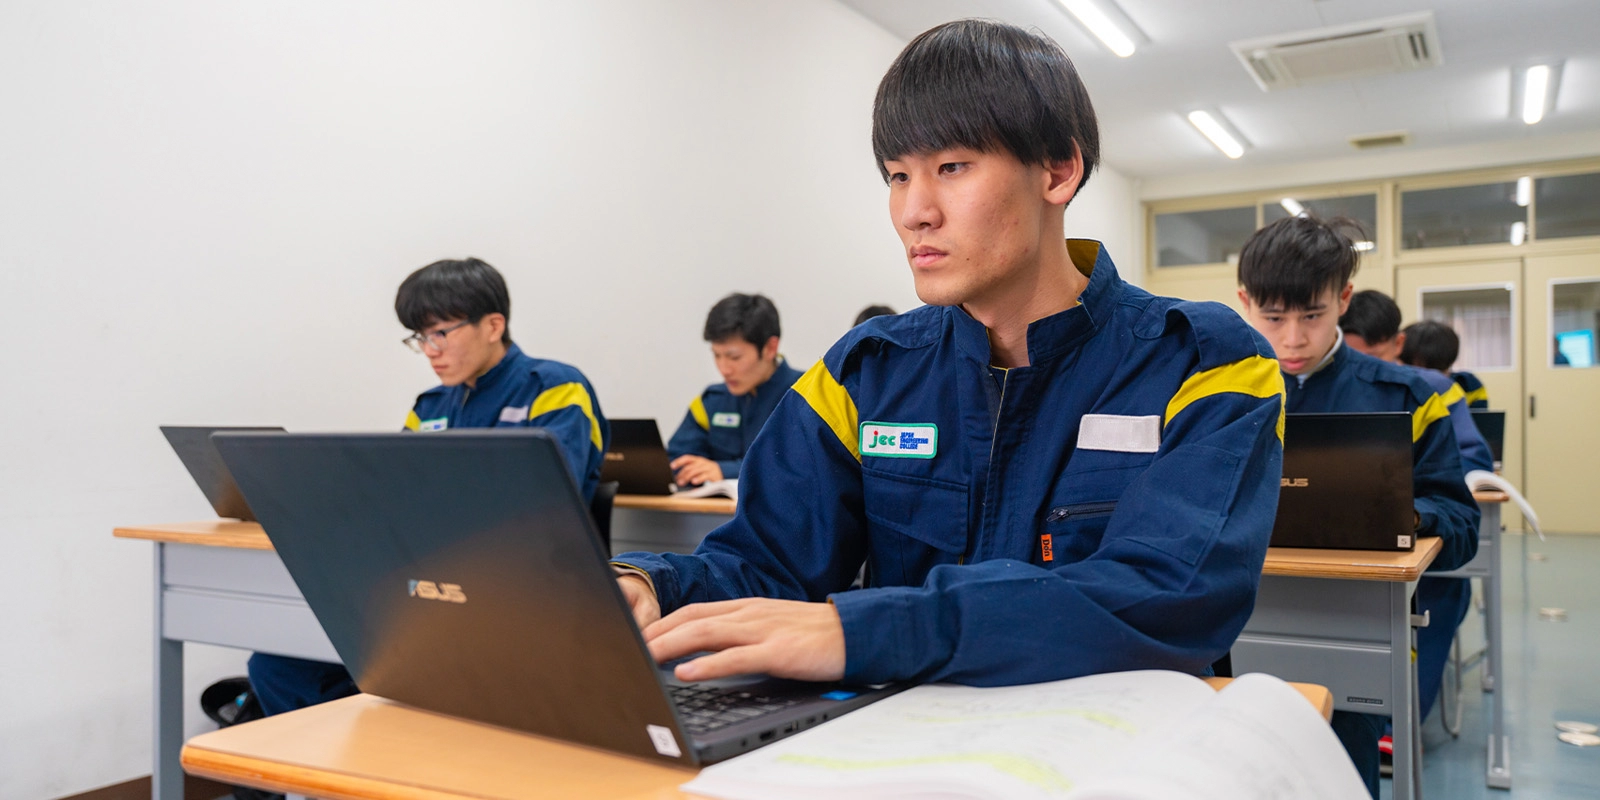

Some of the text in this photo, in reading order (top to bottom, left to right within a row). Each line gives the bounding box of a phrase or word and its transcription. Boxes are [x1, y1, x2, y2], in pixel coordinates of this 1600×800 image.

[868, 430, 896, 448] jec
[1280, 477, 1309, 487] SUS
[407, 579, 468, 604] ASUS
